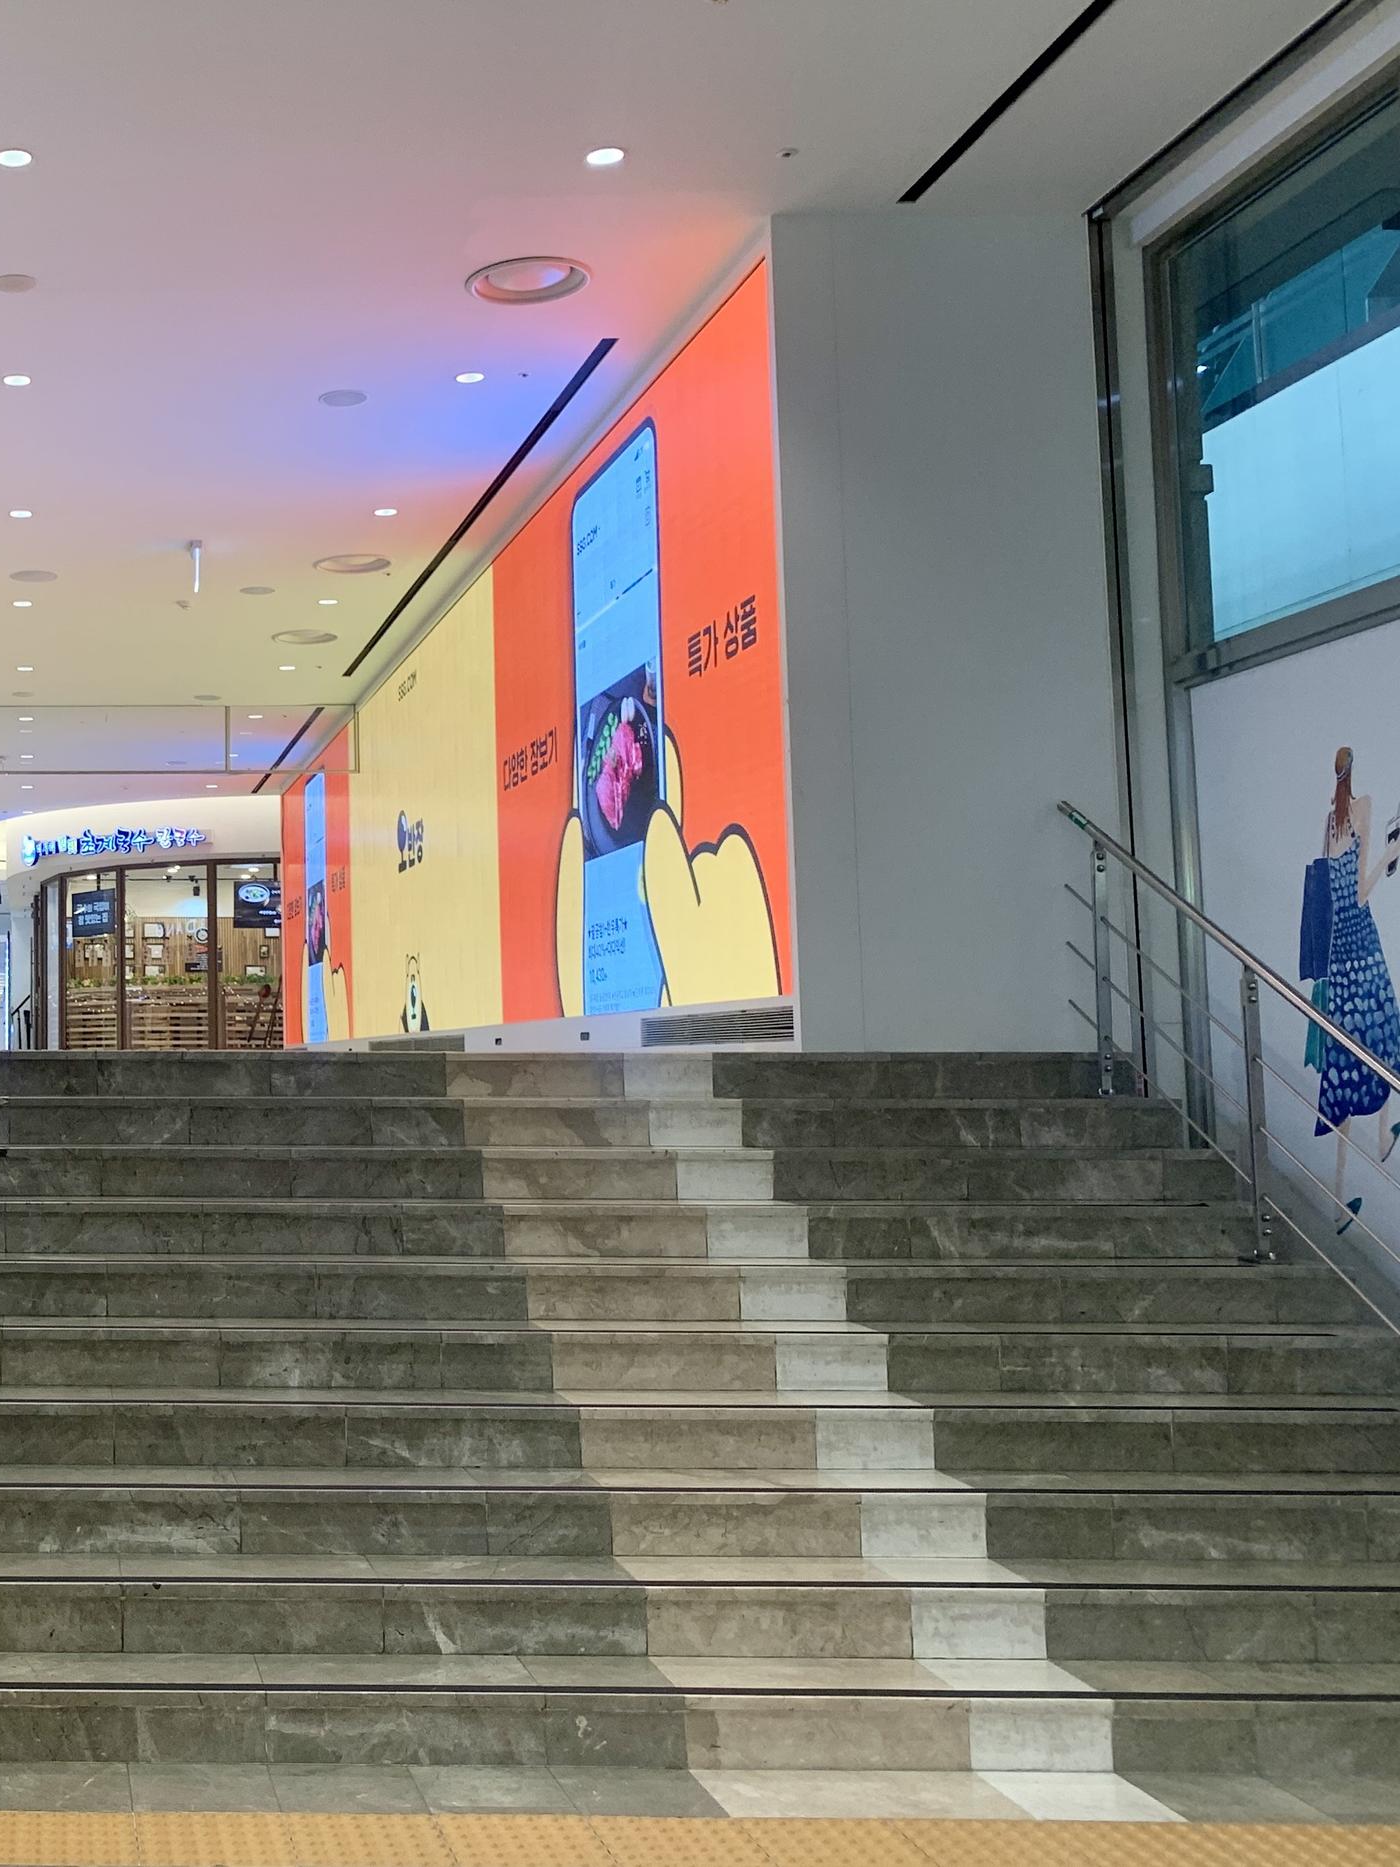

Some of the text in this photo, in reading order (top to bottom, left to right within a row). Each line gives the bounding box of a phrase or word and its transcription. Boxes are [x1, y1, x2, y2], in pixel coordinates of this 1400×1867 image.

[687, 594, 757, 678] 특가 상품
[503, 726, 558, 792] 다양한 장보기
